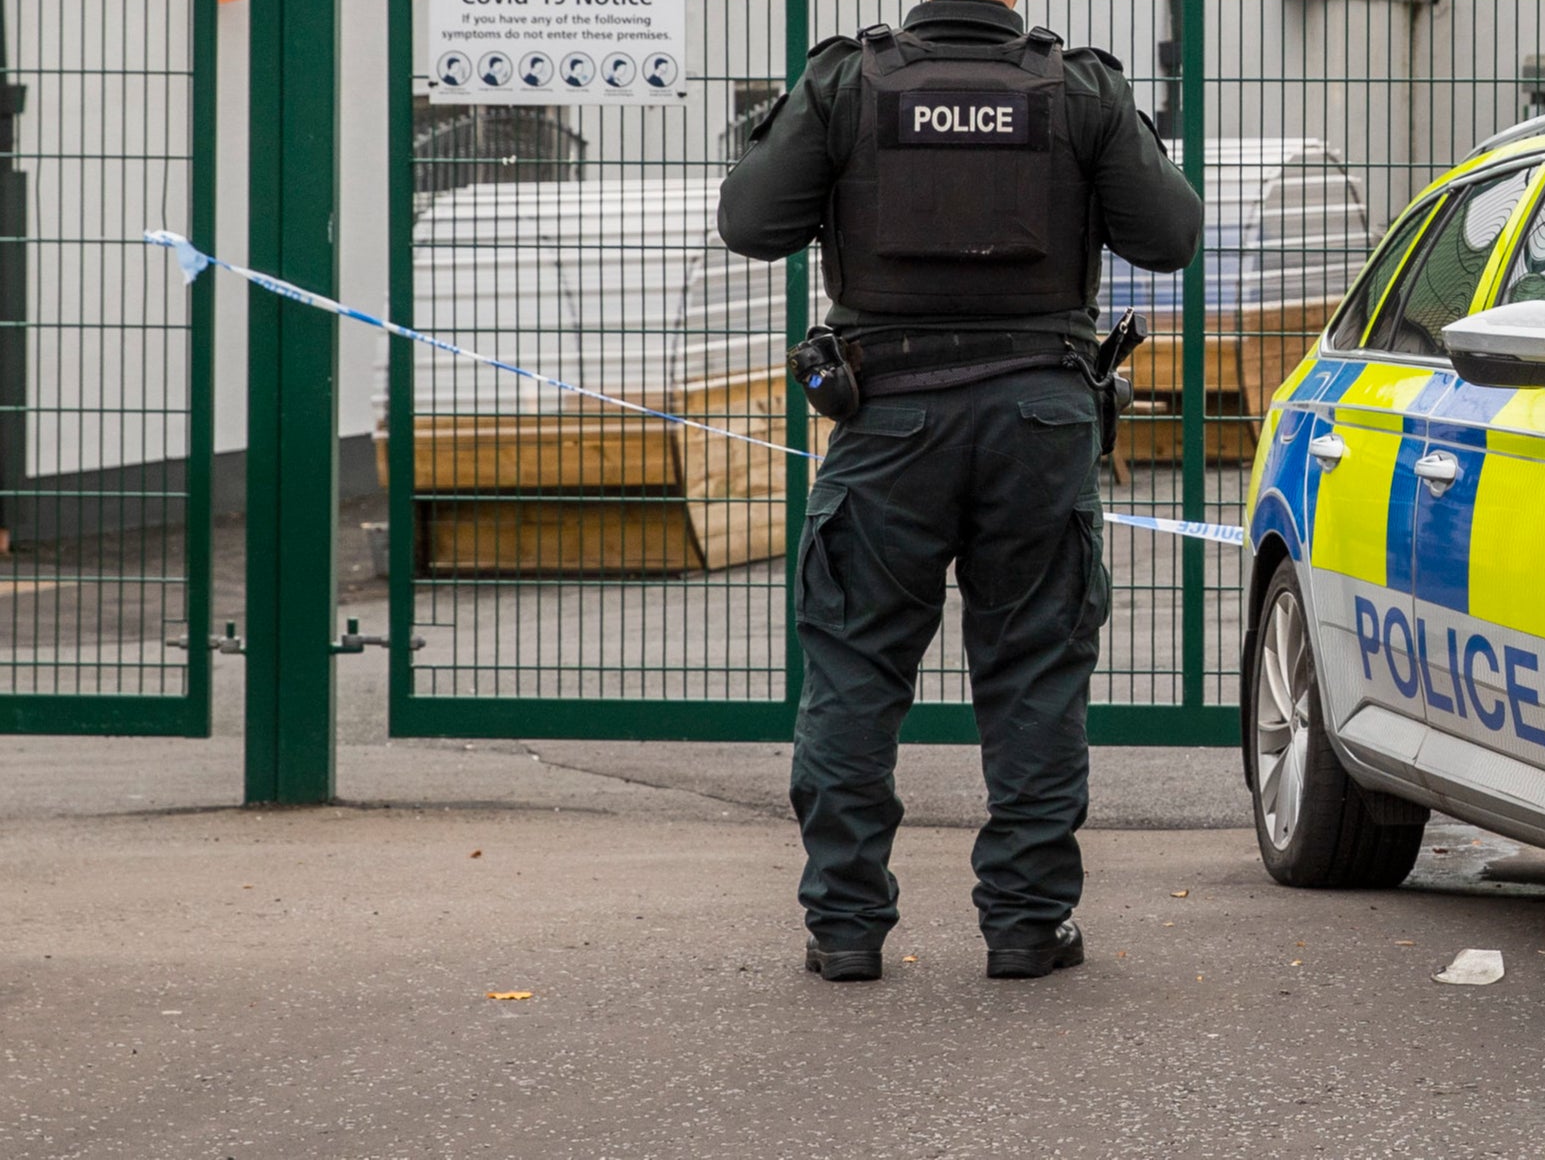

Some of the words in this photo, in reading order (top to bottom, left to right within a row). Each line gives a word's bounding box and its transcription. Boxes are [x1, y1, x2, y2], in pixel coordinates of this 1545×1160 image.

[461, 13, 470, 24] If
[474, 16, 496, 27] you
[499, 13, 527, 24] have
[530, 16, 553, 27] any
[555, 14, 568, 25] of
[571, 14, 592, 25] the
[595, 14, 652, 28] following
[441, 29, 502, 42] symptoms
[504, 28, 521, 40] do
[523, 29, 544, 40] not
[546, 30, 578, 41] enter
[581, 29, 613, 41] these
[616, 29, 673, 43] premises.
[914, 105, 1013, 133] POLICE
